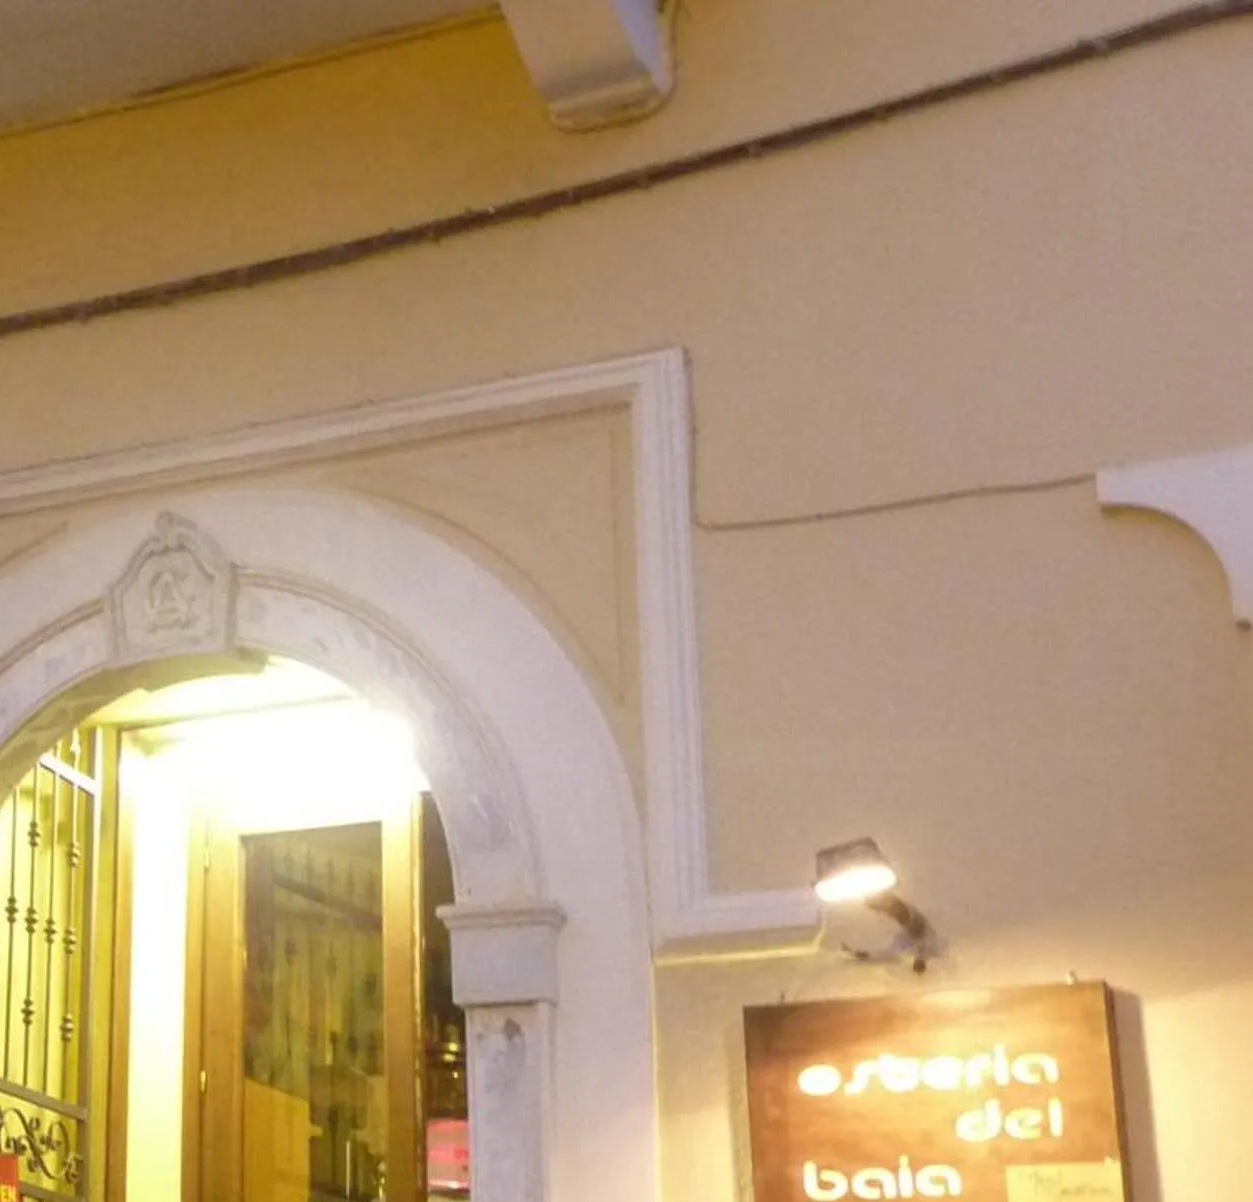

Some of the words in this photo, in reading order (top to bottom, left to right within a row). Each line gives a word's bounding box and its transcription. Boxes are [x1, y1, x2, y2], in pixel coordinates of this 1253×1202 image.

[798, 1043, 1059, 1095] osteria
[956, 1097, 1063, 1143] del
[803, 1154, 962, 1202] baia
